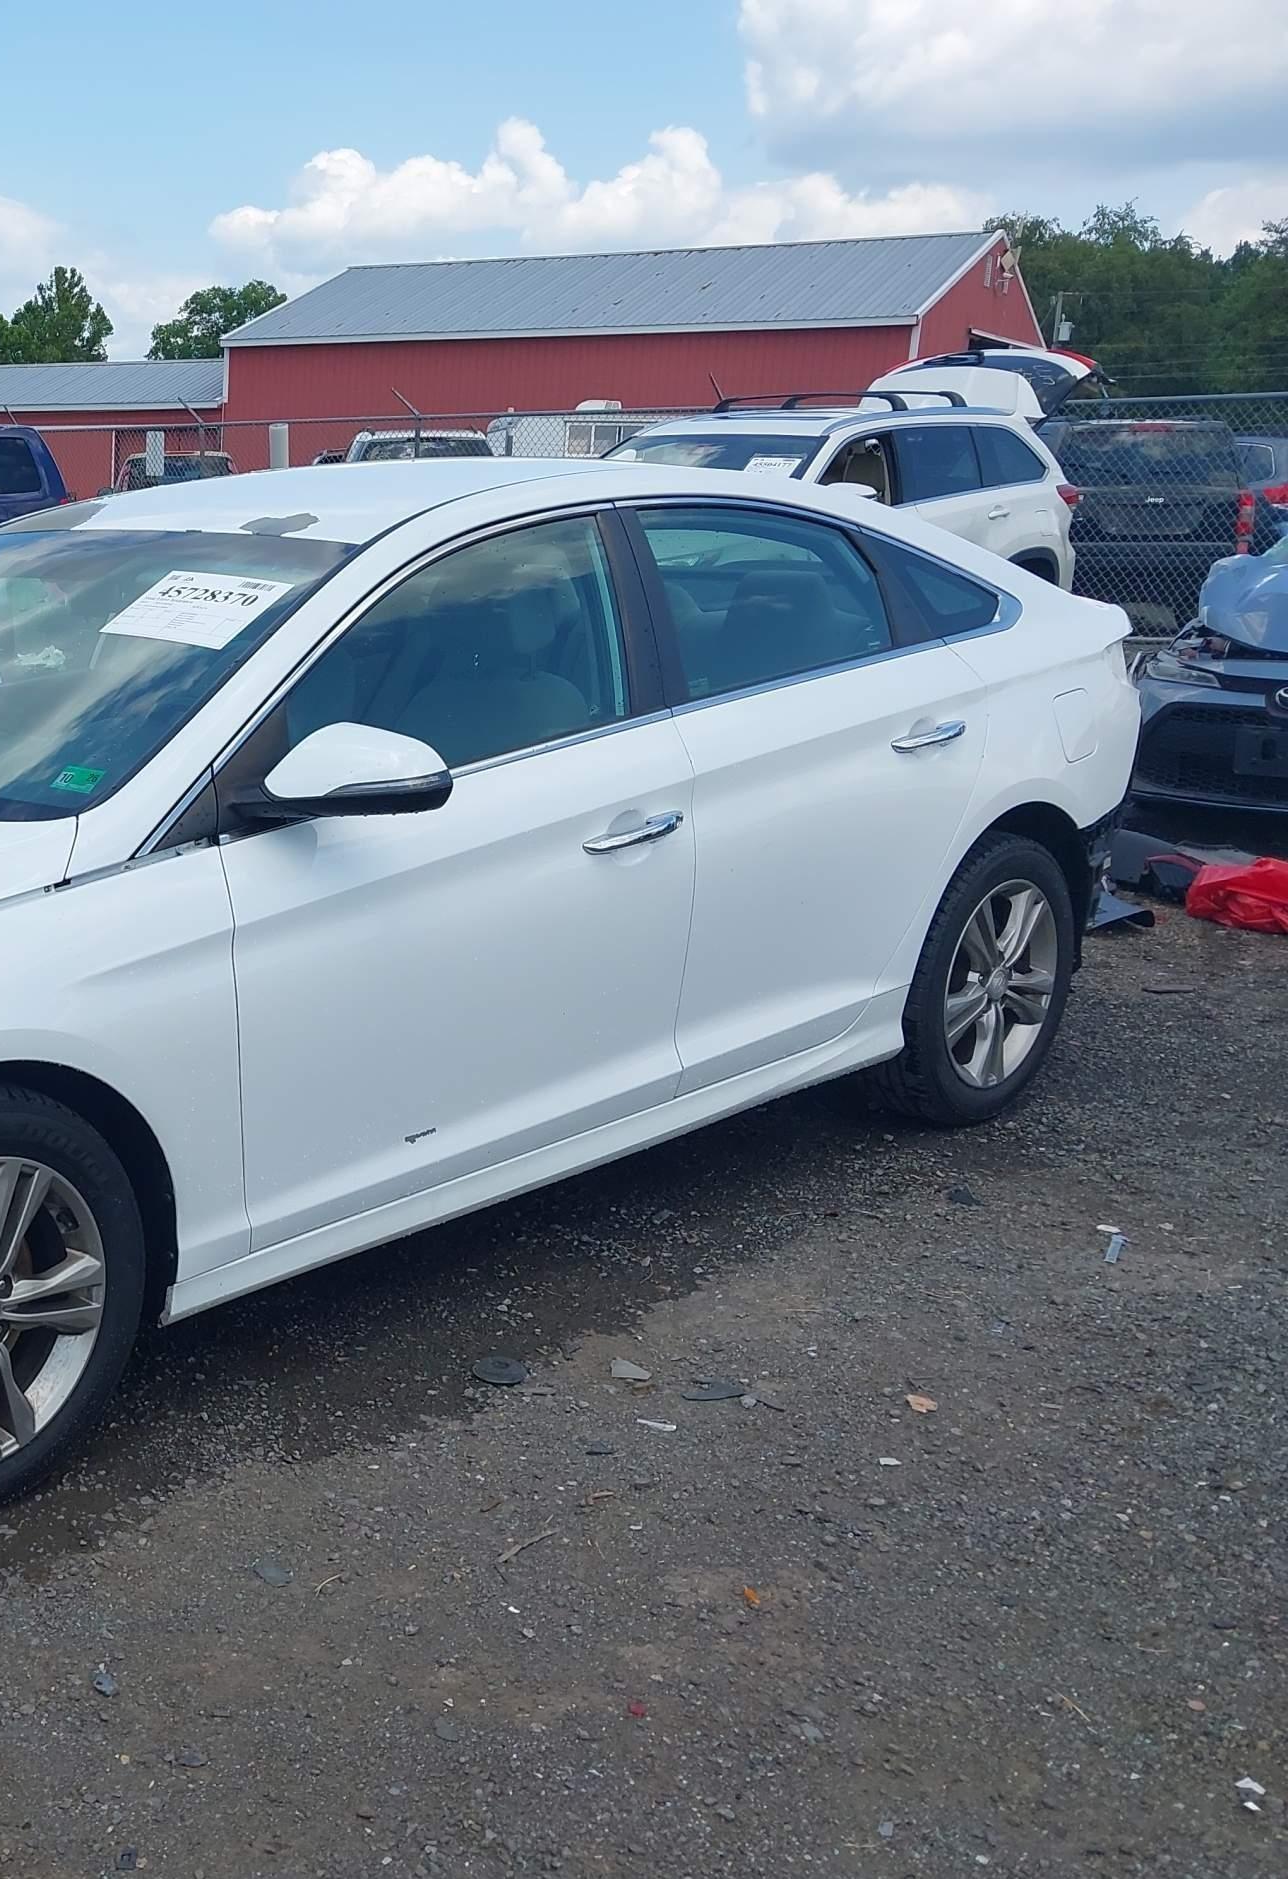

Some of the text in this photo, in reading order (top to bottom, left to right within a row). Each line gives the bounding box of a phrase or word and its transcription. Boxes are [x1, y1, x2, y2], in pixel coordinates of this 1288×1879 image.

[1144, 495, 1165, 504] Jeep
[158, 585, 259, 607] 45728370
[59, 772, 74, 784] 10
